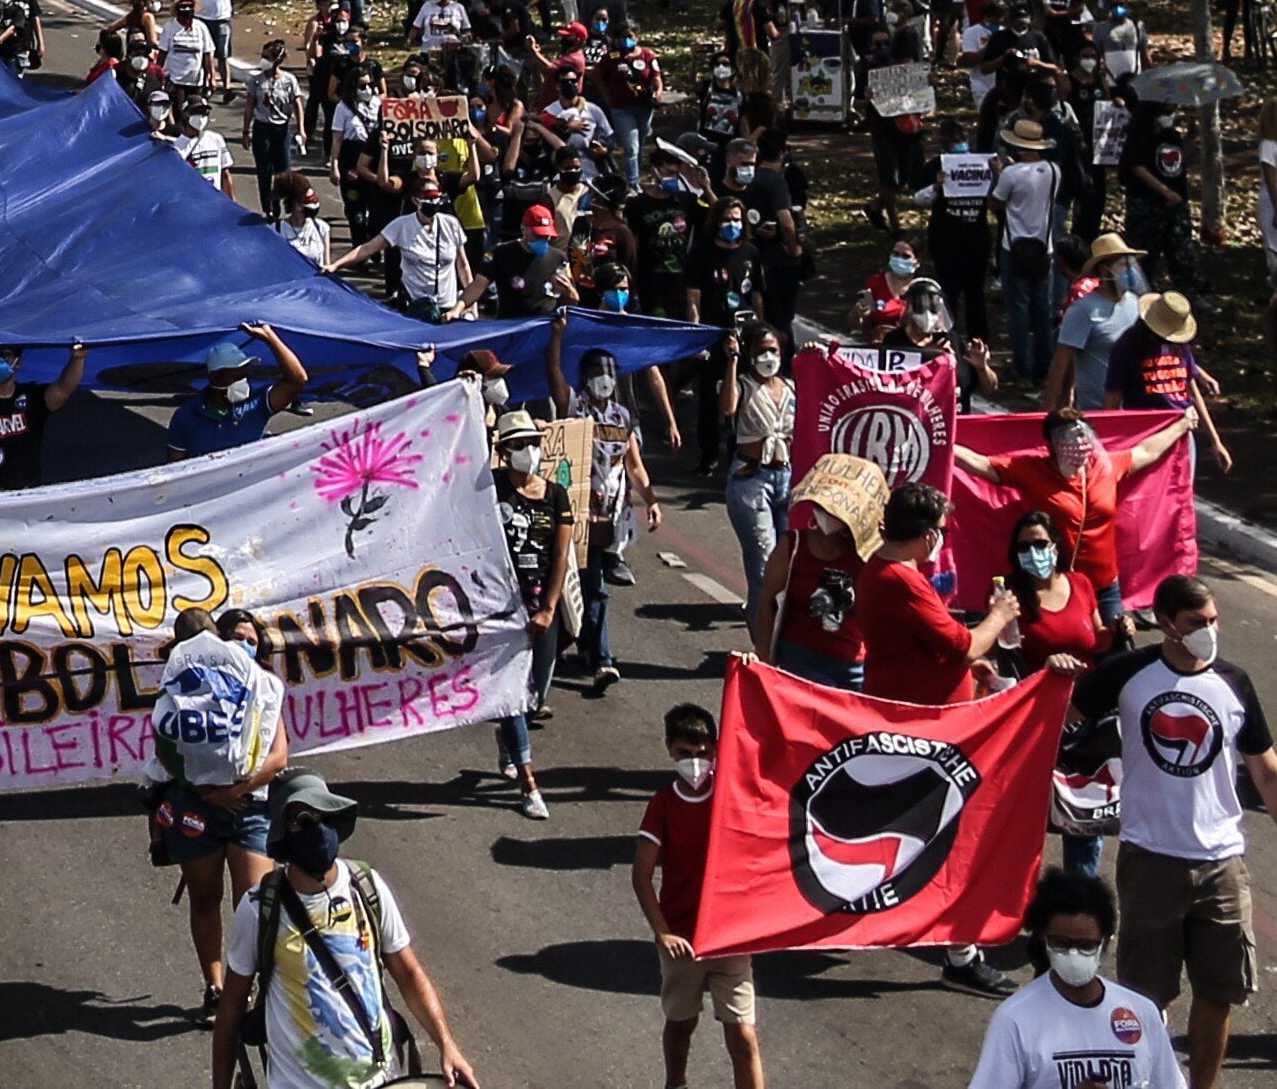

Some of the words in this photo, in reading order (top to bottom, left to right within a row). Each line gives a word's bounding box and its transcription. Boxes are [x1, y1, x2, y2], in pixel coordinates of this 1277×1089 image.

[382, 98, 433, 120] FORA
[383, 118, 469, 142] BOLSONARO
[950, 169, 992, 181] VACINA
